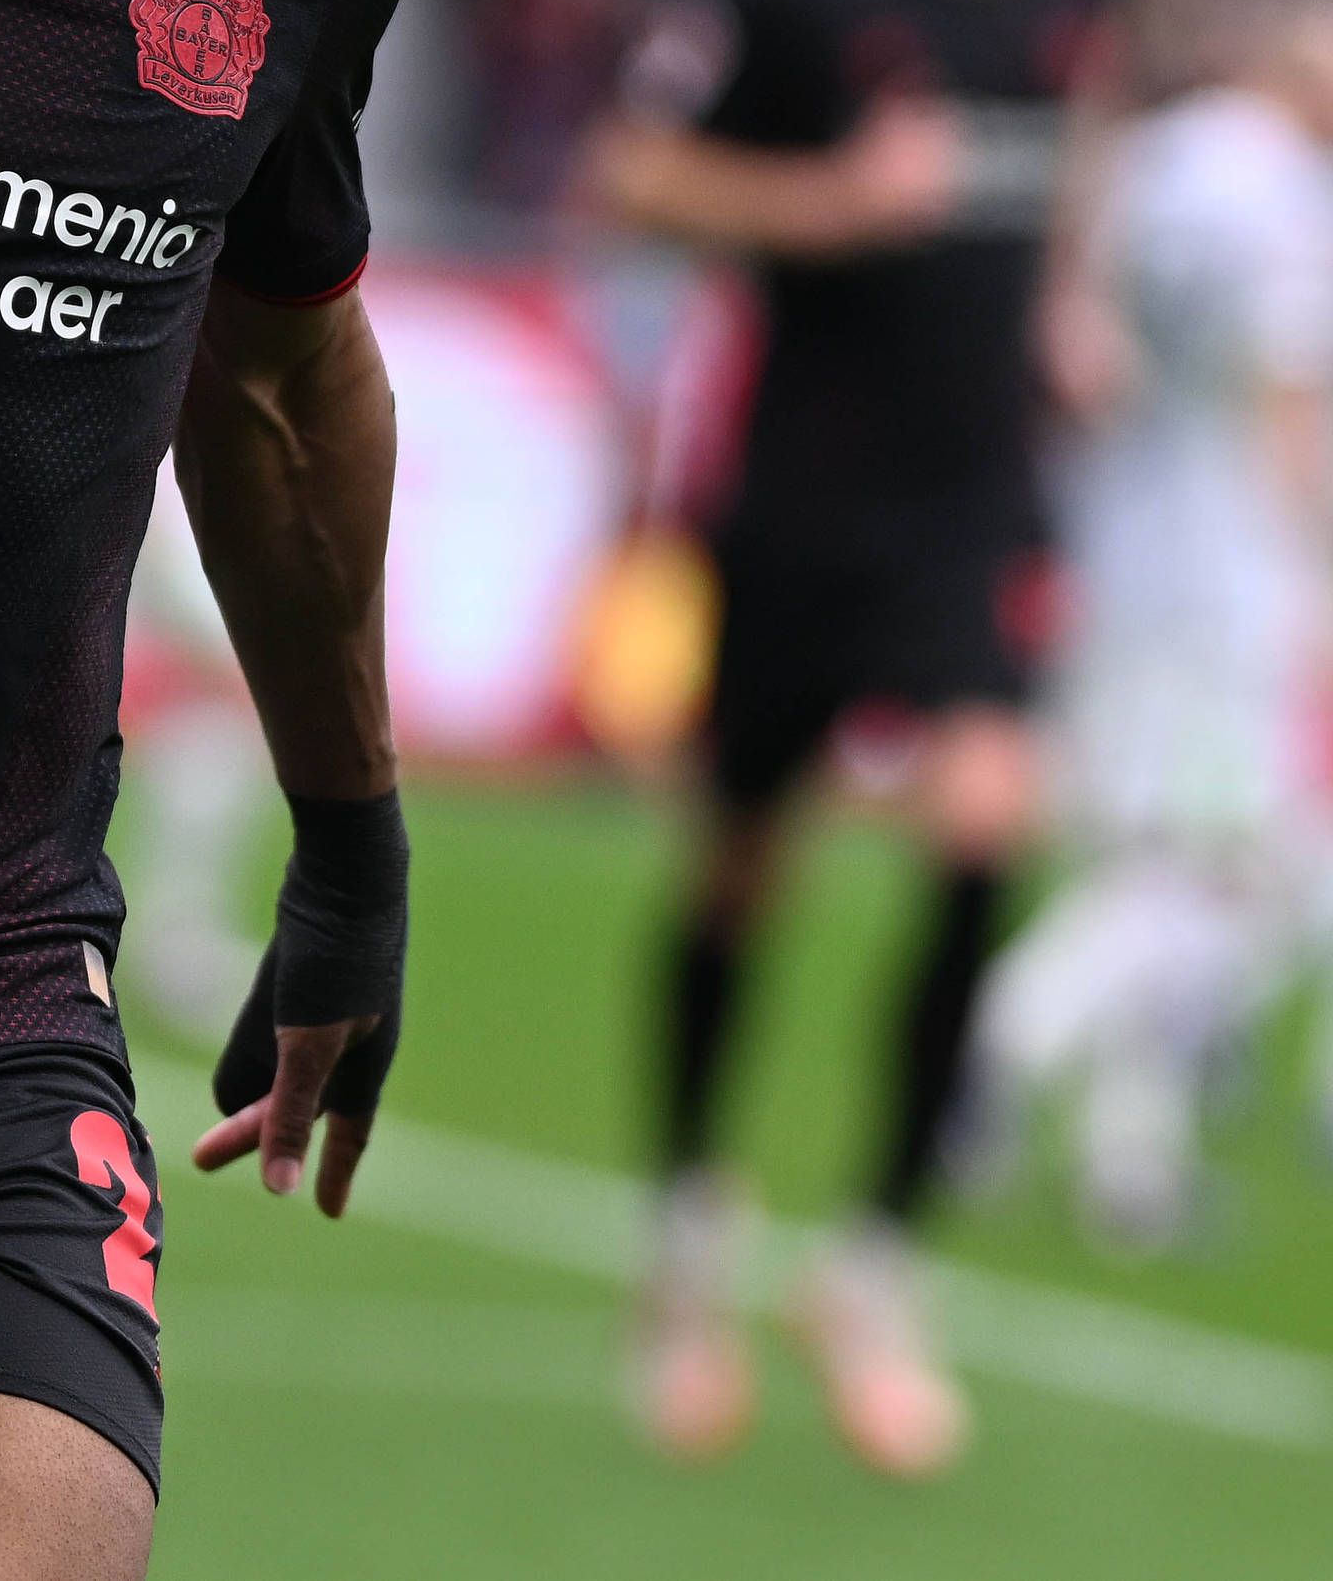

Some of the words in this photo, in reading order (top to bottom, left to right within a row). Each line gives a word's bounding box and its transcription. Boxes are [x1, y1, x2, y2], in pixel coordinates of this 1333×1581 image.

[175, 25, 229, 58] BAYER
[192, 7, 214, 79] BAYER
[150, 61, 236, 105] Leverkusen
